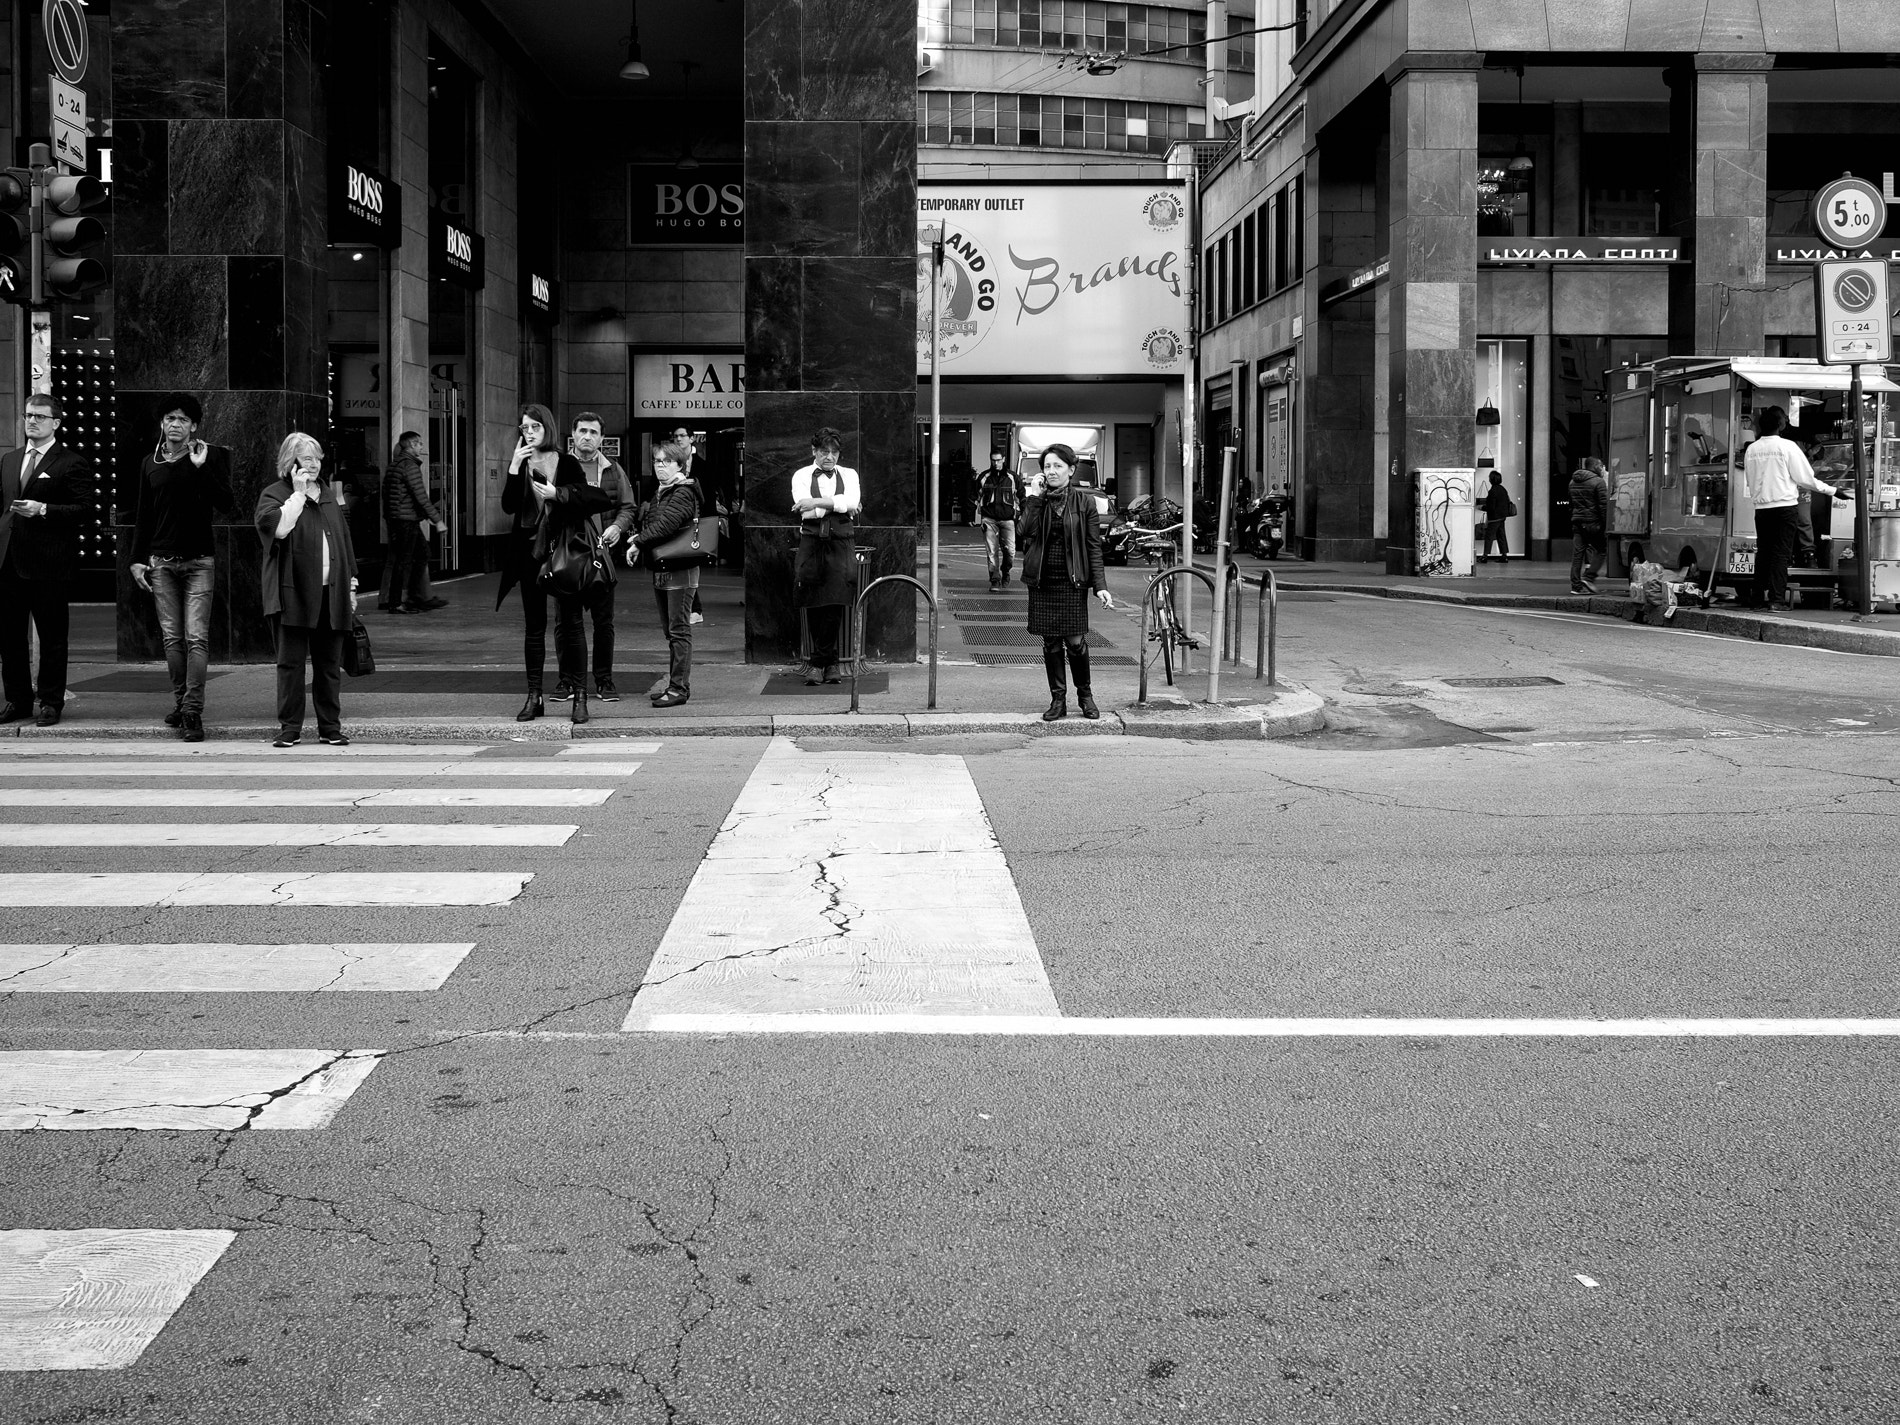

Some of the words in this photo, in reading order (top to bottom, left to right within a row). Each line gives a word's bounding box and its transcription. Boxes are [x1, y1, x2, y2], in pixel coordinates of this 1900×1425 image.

[347, 165, 383, 213] BOSS
[655, 183, 744, 215] BOS
[985, 199, 1024, 210] OUTLET
[1143, 193, 1159, 214] TOUCH
[1169, 193, 1181, 206] AND
[1178, 207, 1184, 218] GO
[656, 219, 705, 227] HUGO
[446, 224, 471, 262] BOSS
[1491, 249, 1587, 259] LIVIANA
[1605, 249, 1677, 259] CONTI
[945, 233, 985, 272] AND
[978, 279, 995, 311] GO
[1008, 243, 1181, 326] Brands
[532, 273, 549, 303] BOSS
[1142, 330, 1158, 351] TOUCH
[1168, 330, 1180, 343] AND
[686, 400, 723, 409] DELLE
[1739, 553, 1750, 563] ZA
